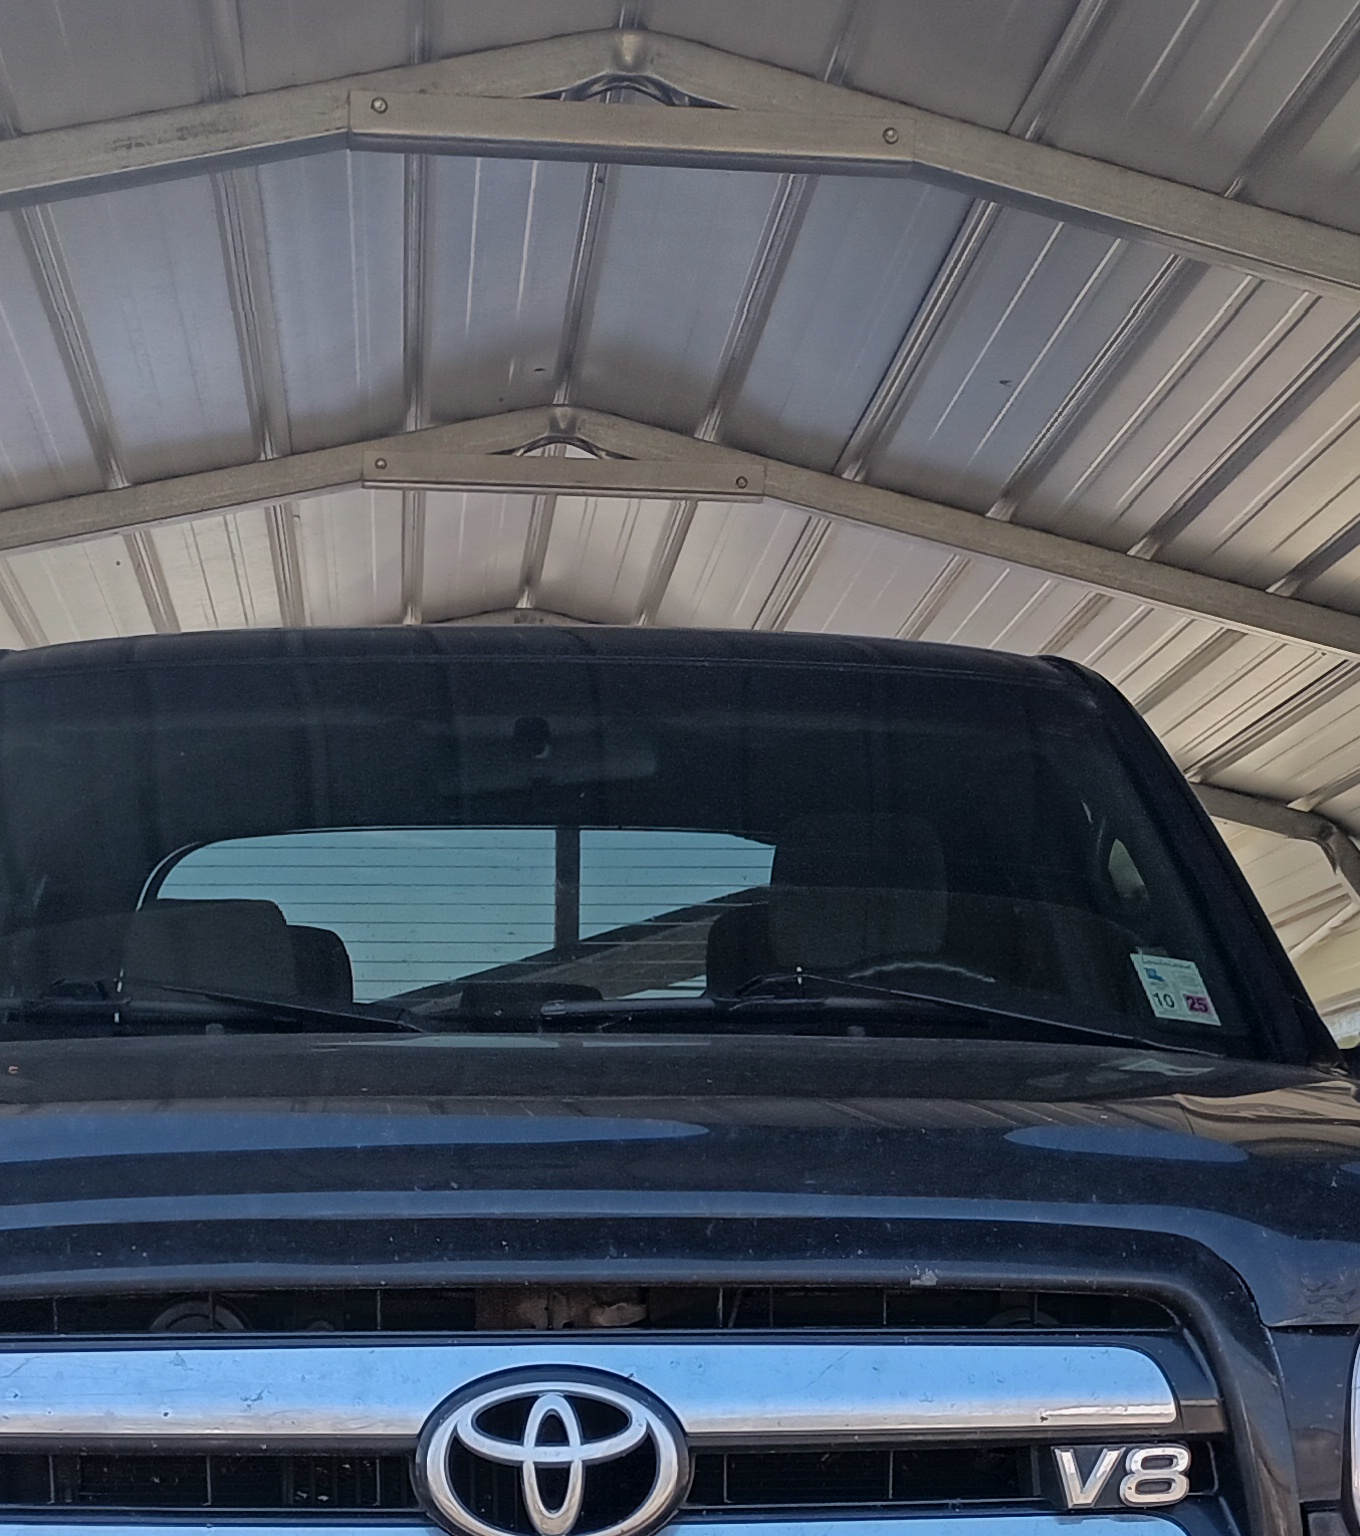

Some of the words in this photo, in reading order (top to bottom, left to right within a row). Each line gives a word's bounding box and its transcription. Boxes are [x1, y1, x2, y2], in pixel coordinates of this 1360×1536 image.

[1153, 992, 1175, 1009] 10
[1186, 995, 1209, 1013] 25
[1052, 1446, 1190, 1508] V8
